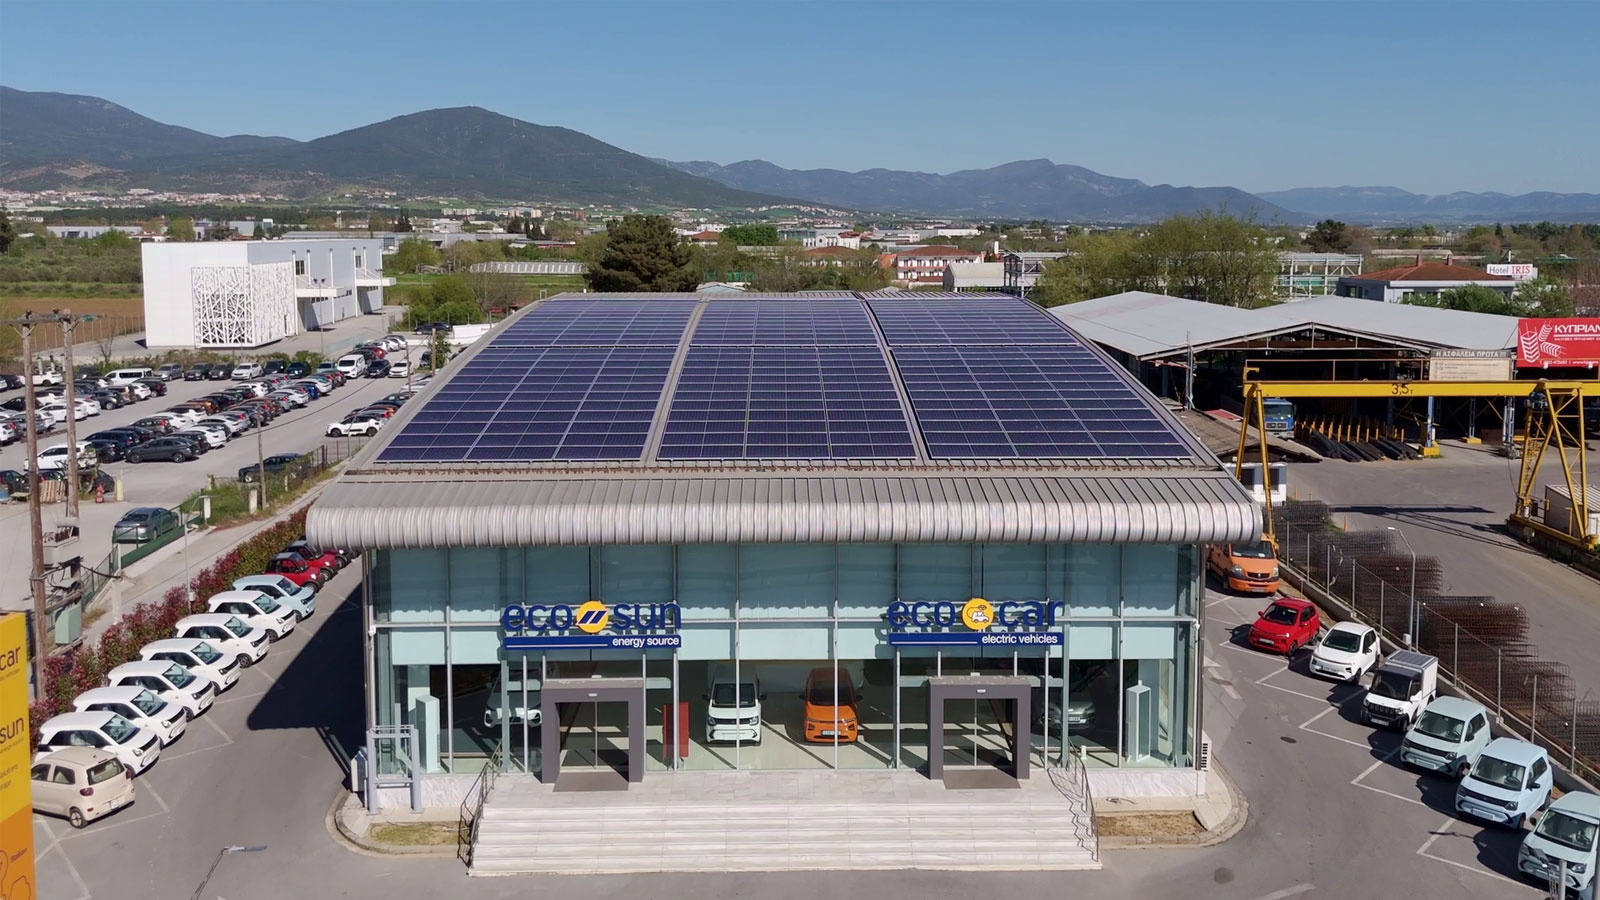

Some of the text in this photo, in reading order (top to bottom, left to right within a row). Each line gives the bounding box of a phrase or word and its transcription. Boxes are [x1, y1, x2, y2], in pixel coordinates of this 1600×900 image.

[1490, 265, 1531, 274] Hotel IRIS
[503, 602, 682, 631] eco sun
[887, 600, 1065, 628] eco car
[612, 637, 680, 648] energy source
[982, 634, 1058, 644] electric vehicles
[0, 646, 21, 671] car
[0, 717, 24, 744] sun
